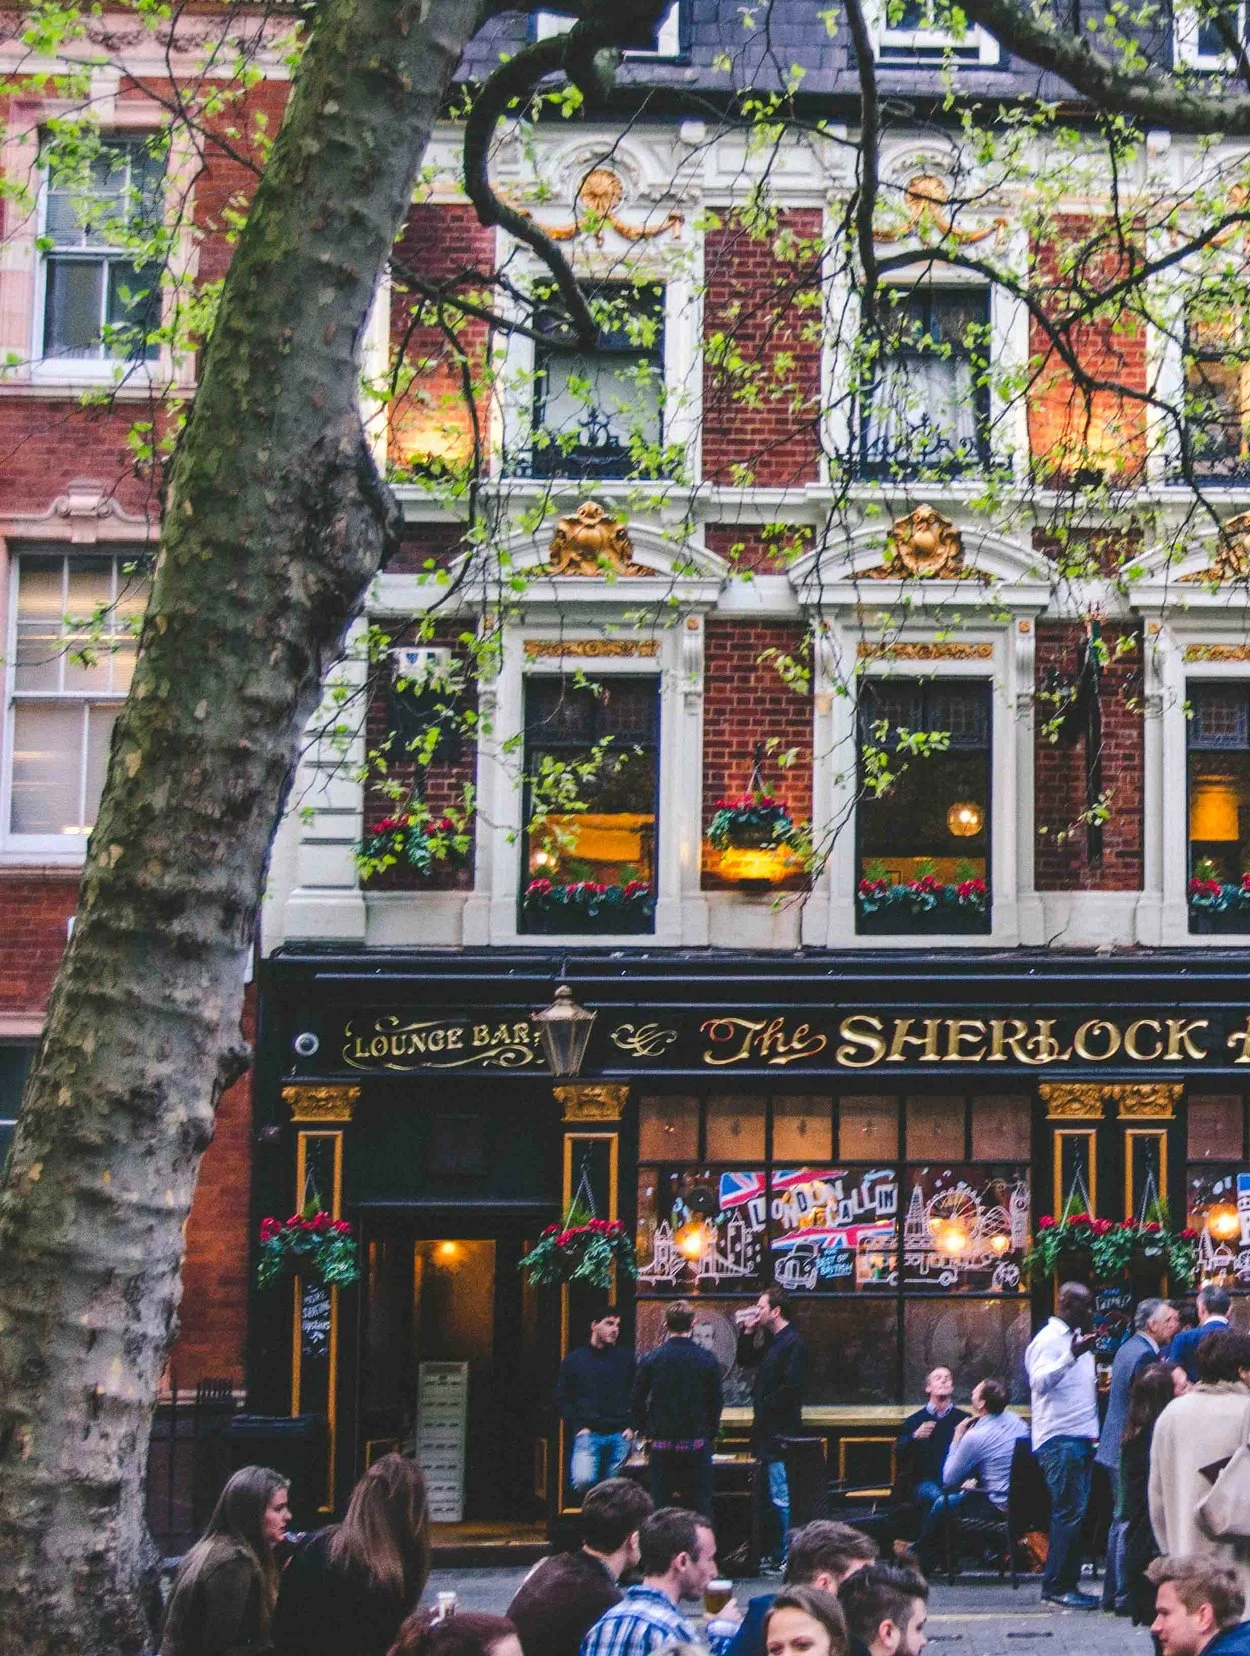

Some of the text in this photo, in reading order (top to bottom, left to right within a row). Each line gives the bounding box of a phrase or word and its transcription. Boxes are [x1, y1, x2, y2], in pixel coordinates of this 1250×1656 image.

[354, 1022, 530, 1058] LOUNGE BAR
[700, 1016, 826, 1065] The
[835, 1015, 1209, 1068] SHERLOCK
